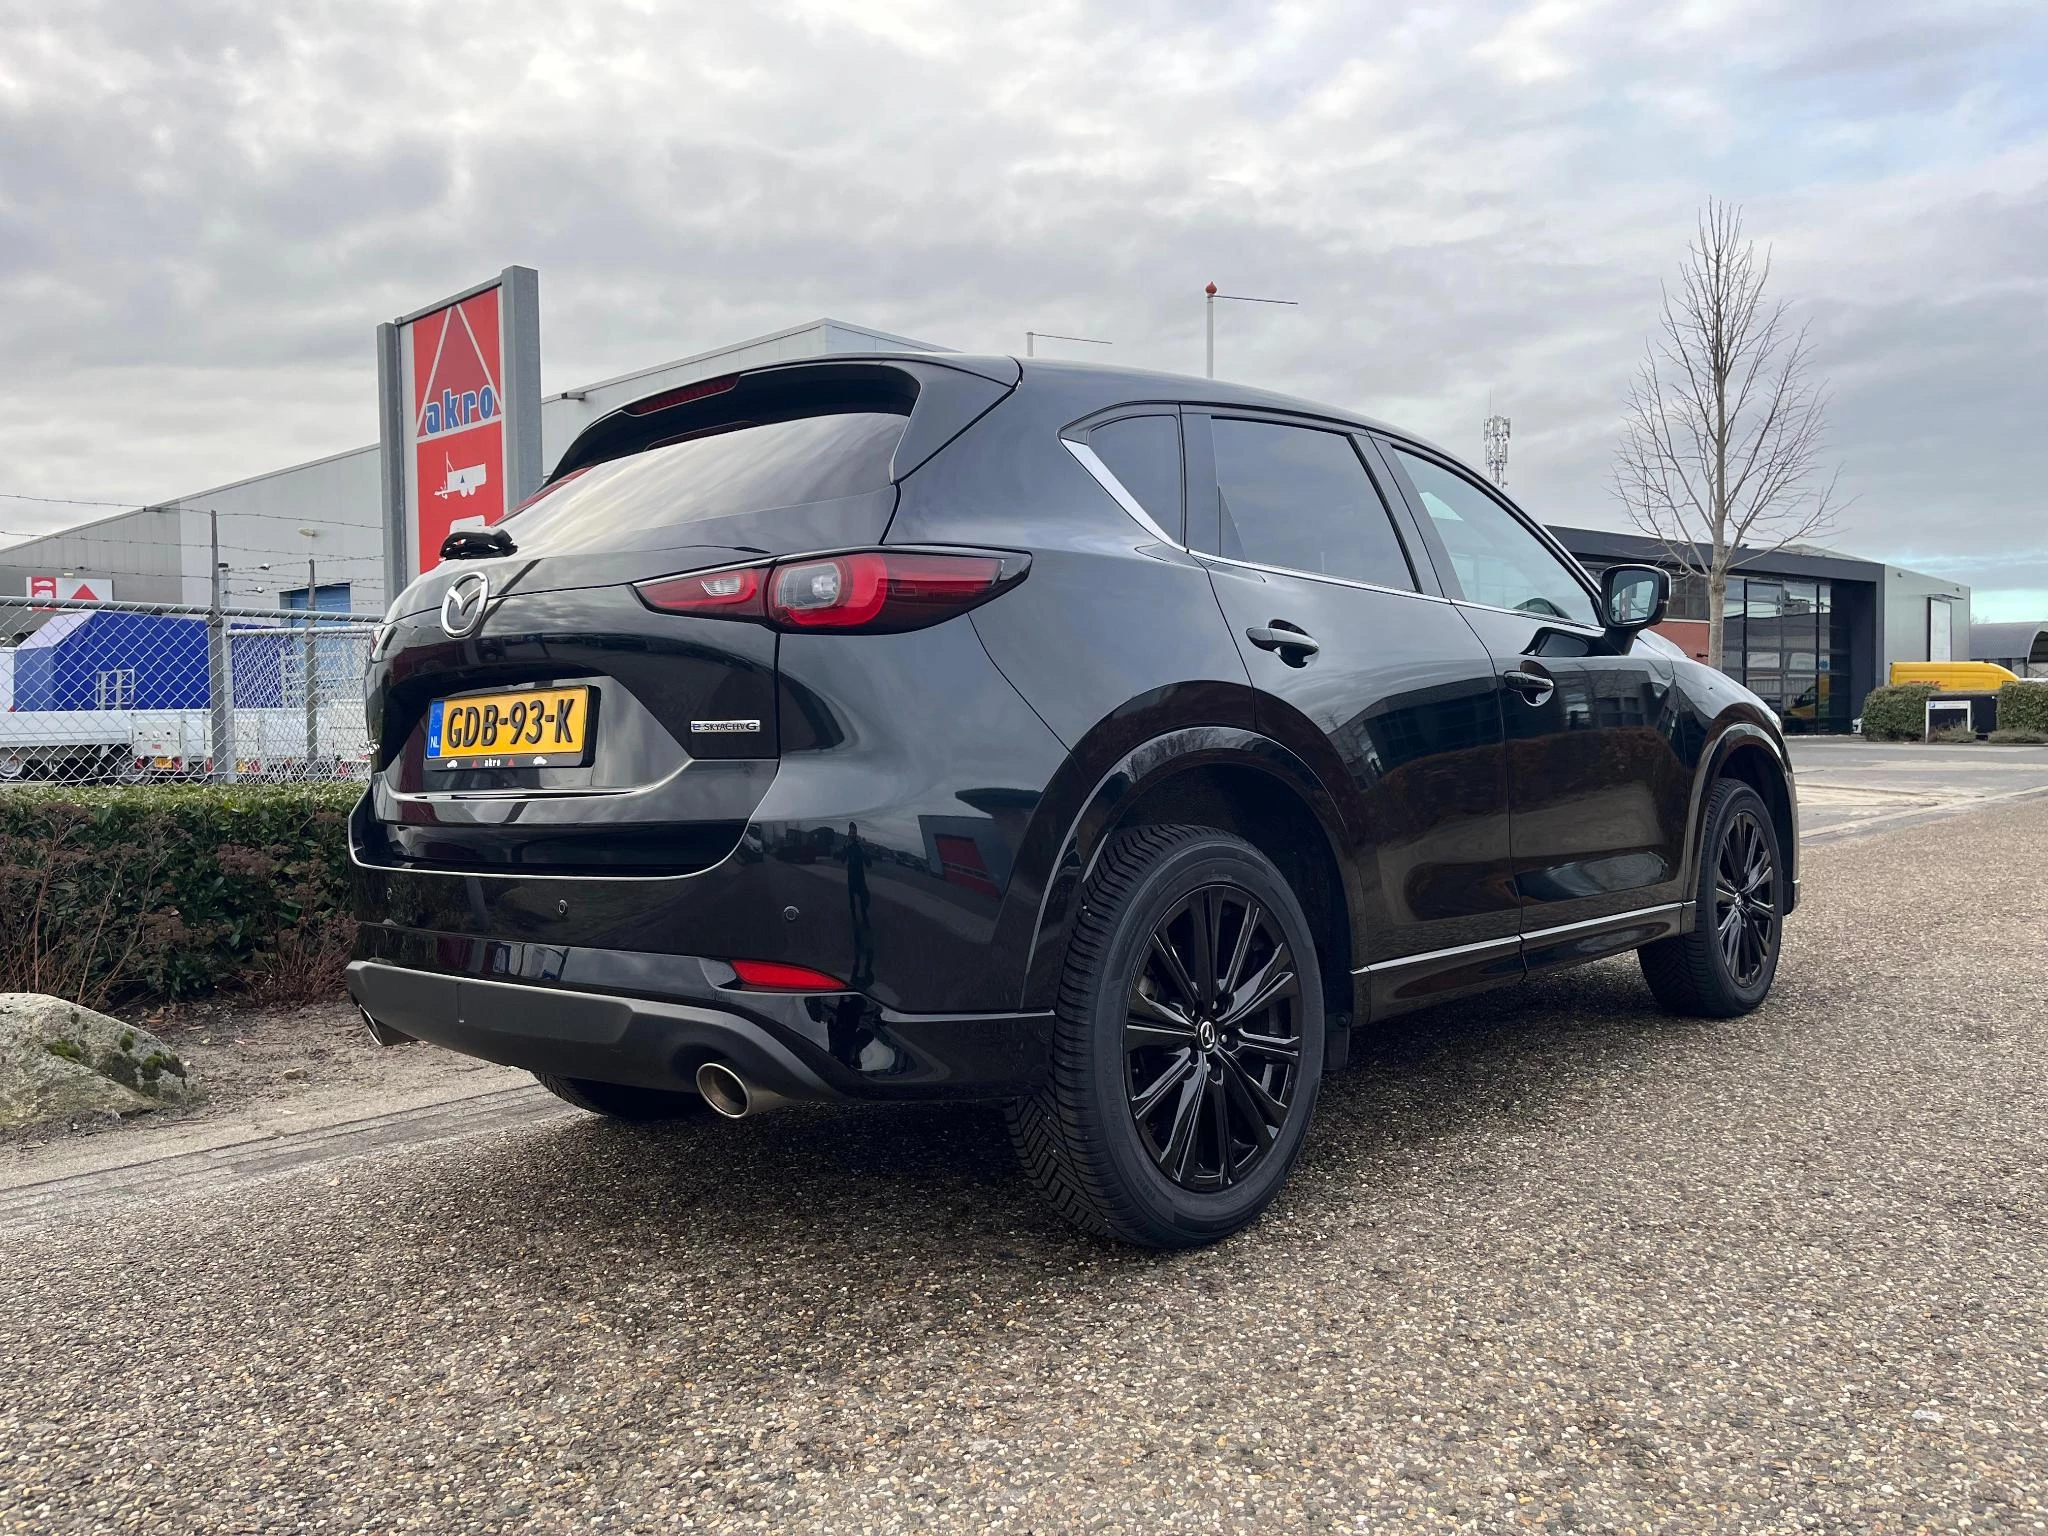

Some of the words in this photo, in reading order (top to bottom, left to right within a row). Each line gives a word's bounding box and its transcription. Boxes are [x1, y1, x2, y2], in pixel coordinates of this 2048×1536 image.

[425, 384, 495, 434] akro
[430, 735, 440, 749] NL
[447, 699, 575, 748] GDB-93-K
